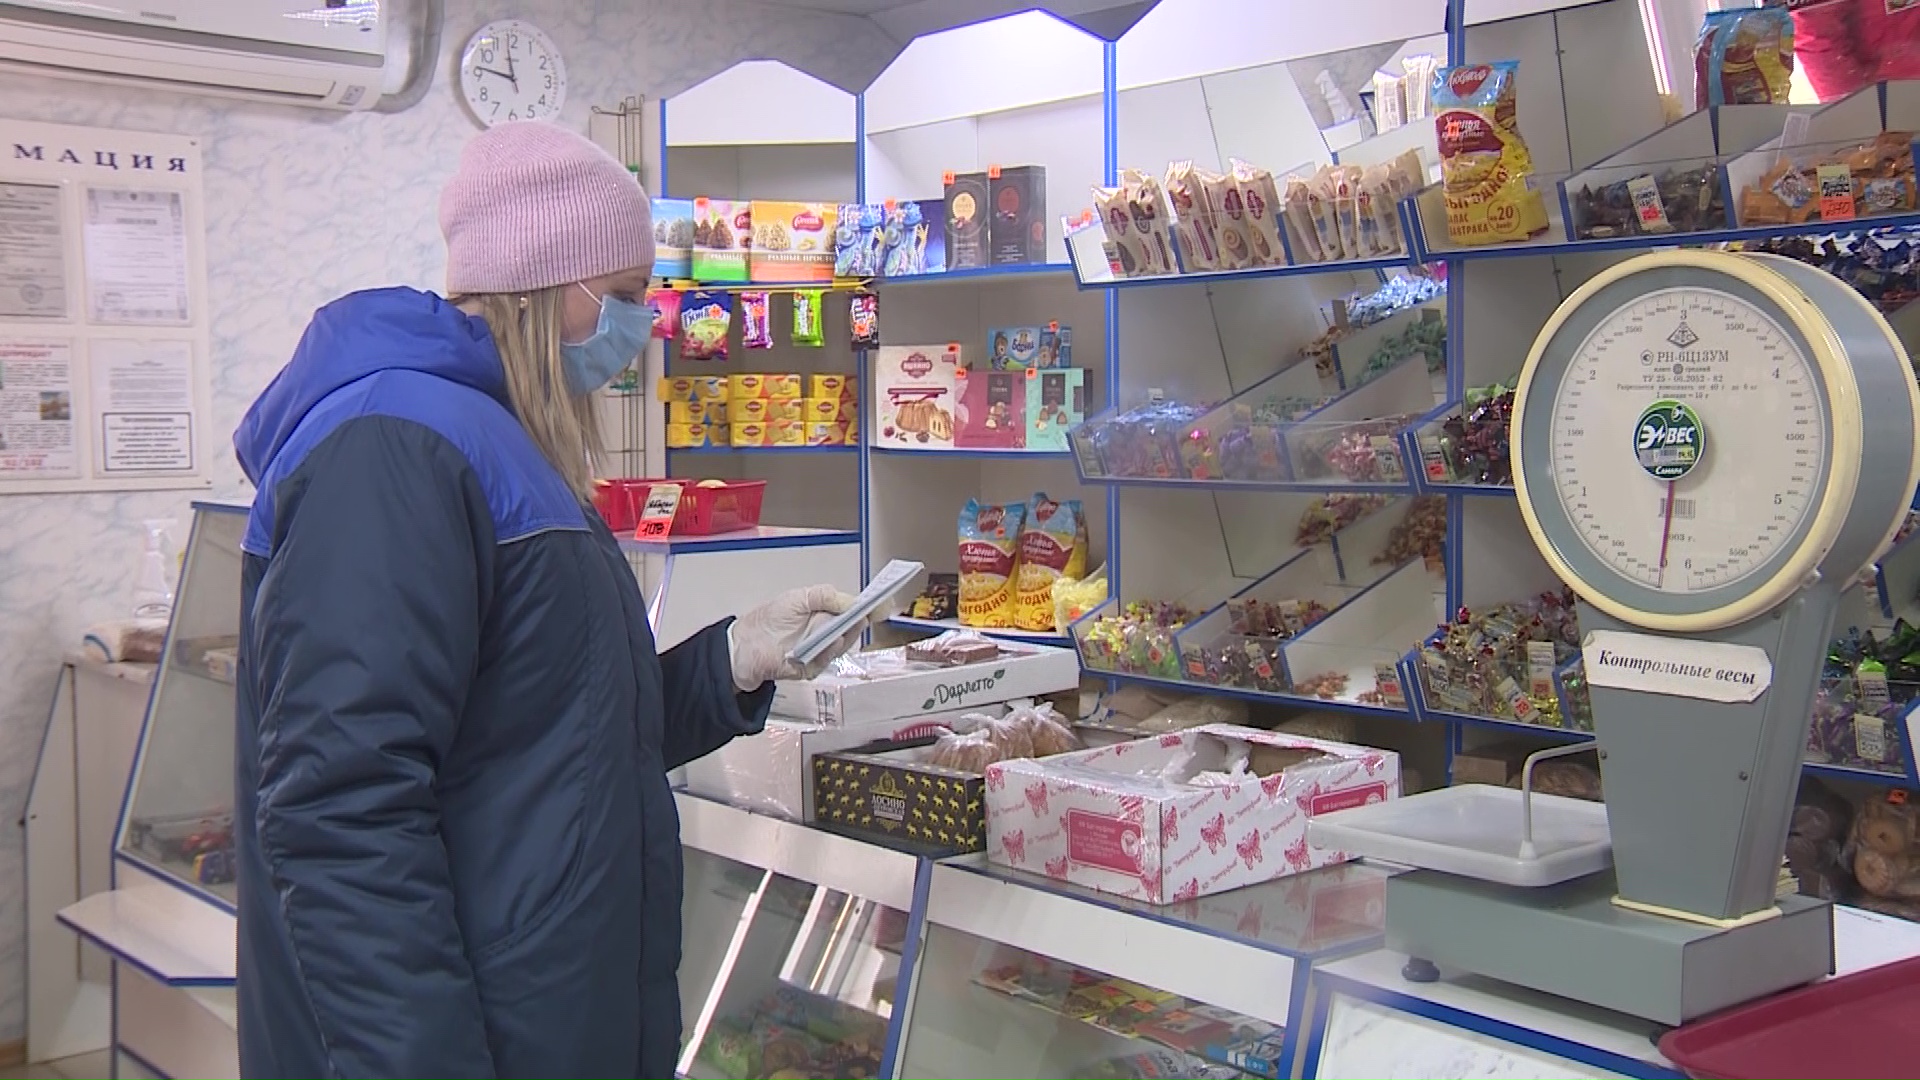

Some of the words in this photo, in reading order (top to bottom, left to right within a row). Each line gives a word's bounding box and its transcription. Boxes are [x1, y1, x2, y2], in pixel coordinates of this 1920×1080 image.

[528, 40, 533, 55] 1
[481, 48, 494, 64] 10
[539, 55, 547, 70] 2
[473, 66, 483, 82] 9
[544, 75, 552, 89] 3
[480, 86, 488, 101] 8
[538, 94, 546, 106] 4
[491, 101, 500, 116] 7
[508, 109, 518, 121] 6
[526, 104, 535, 119] 5
[1445, 165, 1510, 209] ЫГОДНО!
[1449, 213, 1469, 224] АПАС
[1497, 206, 1514, 220] 20
[1680, 309, 1687, 320] 3
[1725, 323, 1745, 331] 3500
[1590, 369, 1597, 381] 2
[1771, 367, 1780, 379] 4
[1785, 433, 1806, 441] 4500
[1774, 494, 1783, 505] 5
[1729, 547, 1748, 556] 5500
[1685, 558, 1692, 570] 6
[959, 589, 1009, 615] ЫГОДНО!
[1598, 649, 1712, 679] Контрольные
[1715, 668, 1757, 685] весы
[934, 677, 995, 705] Дарлетто
